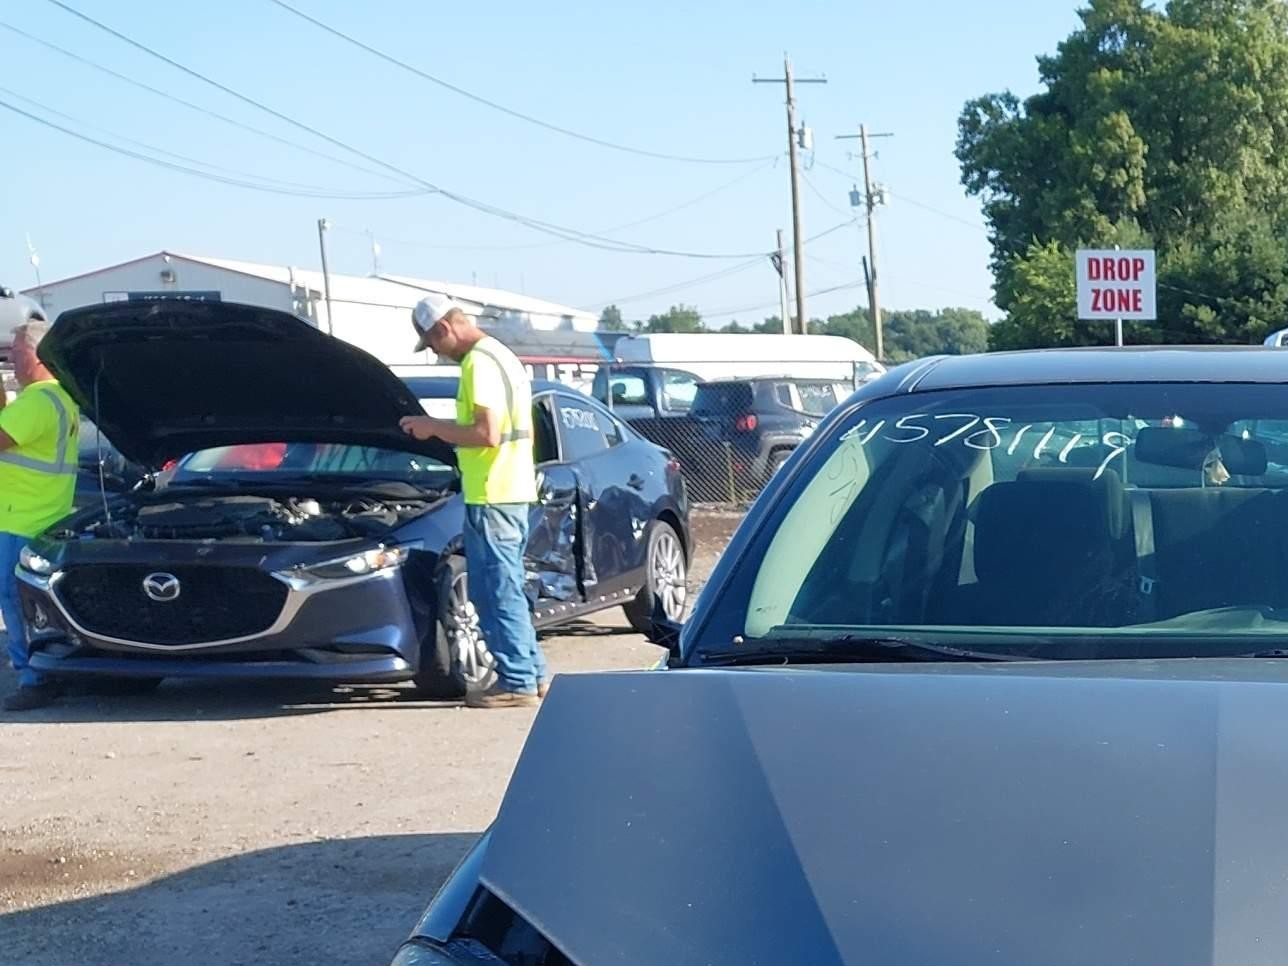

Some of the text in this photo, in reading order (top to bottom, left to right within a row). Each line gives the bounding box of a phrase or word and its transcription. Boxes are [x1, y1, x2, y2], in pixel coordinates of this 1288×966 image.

[1087, 257, 1145, 281] DROP
[1091, 288, 1143, 312] ZONE
[838, 413, 1132, 481] 45781119
